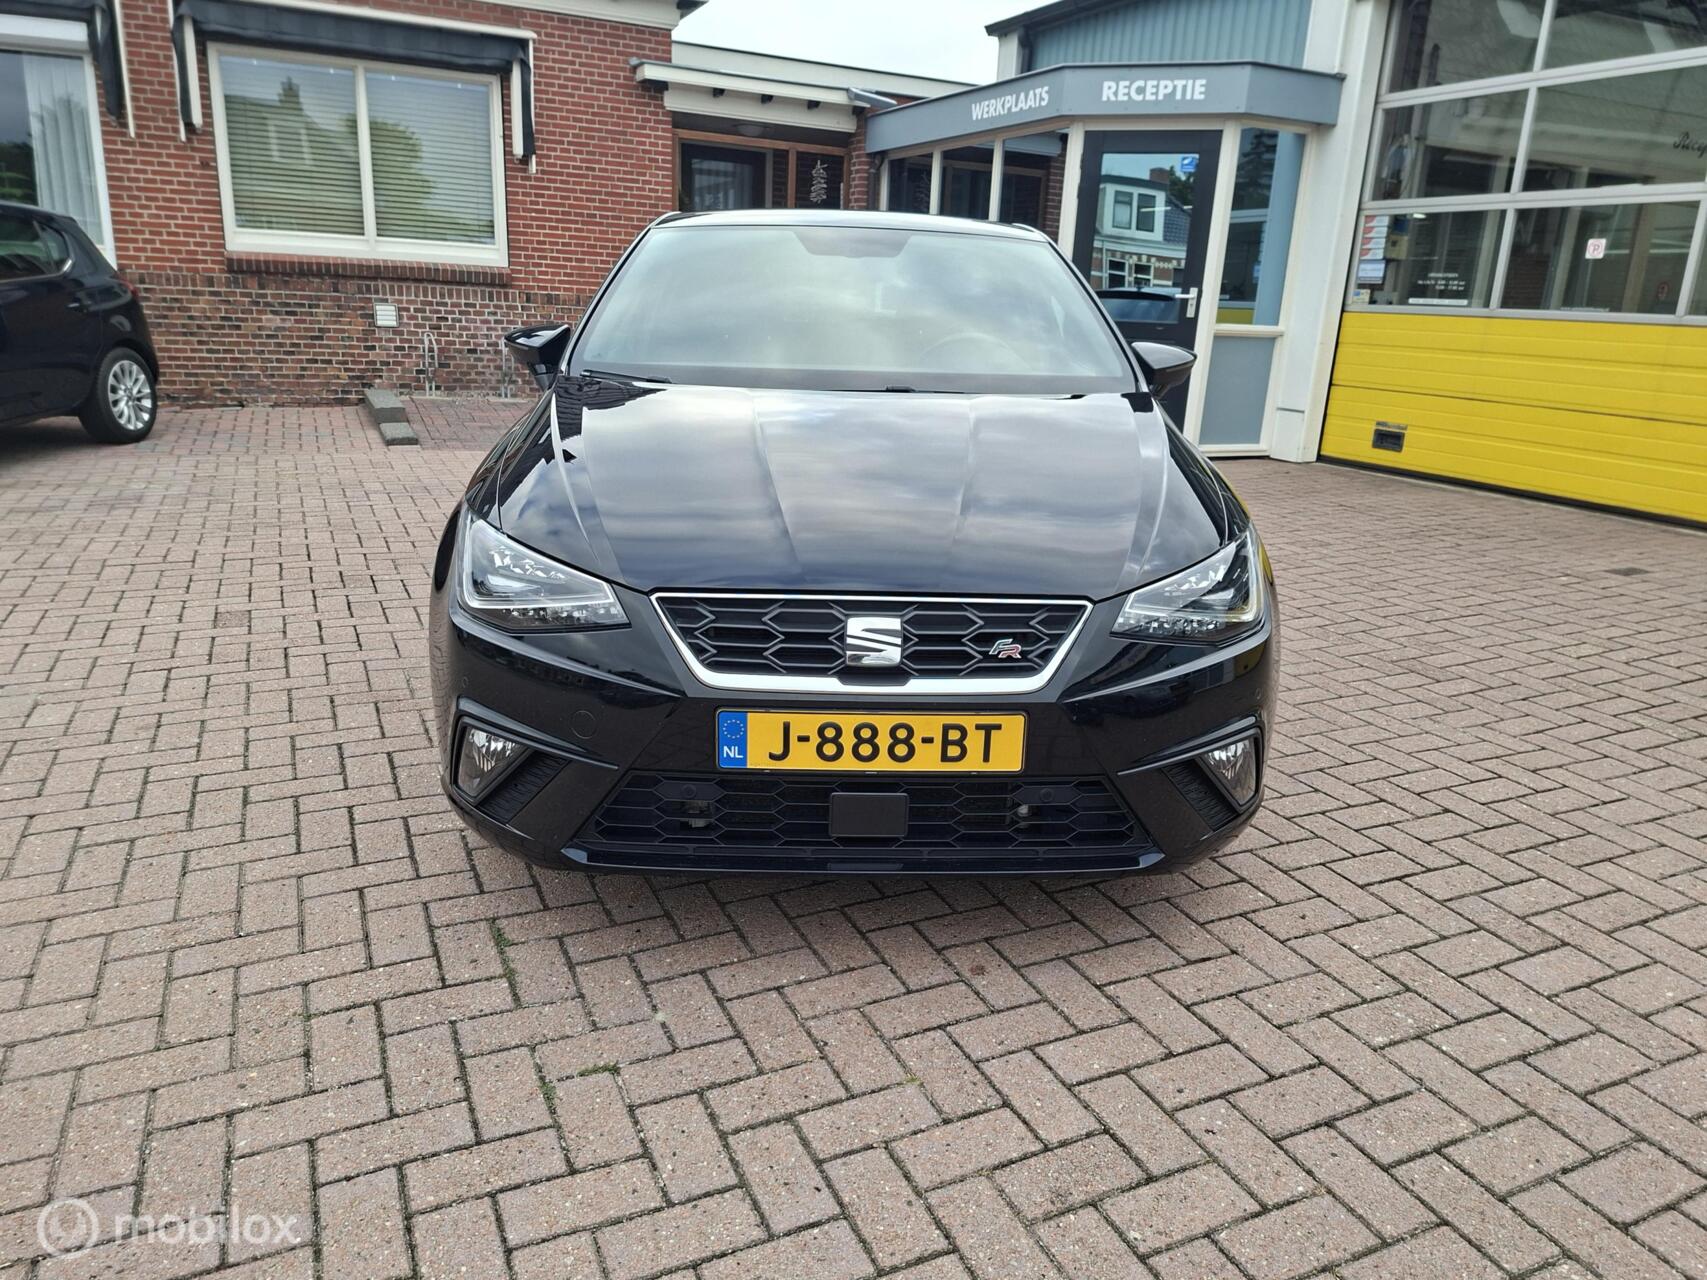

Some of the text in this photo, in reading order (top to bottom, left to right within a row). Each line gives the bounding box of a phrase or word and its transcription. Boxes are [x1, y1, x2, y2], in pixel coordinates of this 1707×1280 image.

[971, 86, 1049, 121] WERKPLAATS
[1102, 79, 1207, 101] RECEPTIE
[723, 745, 743, 759] NL
[768, 720, 1003, 763] J-888-BT
